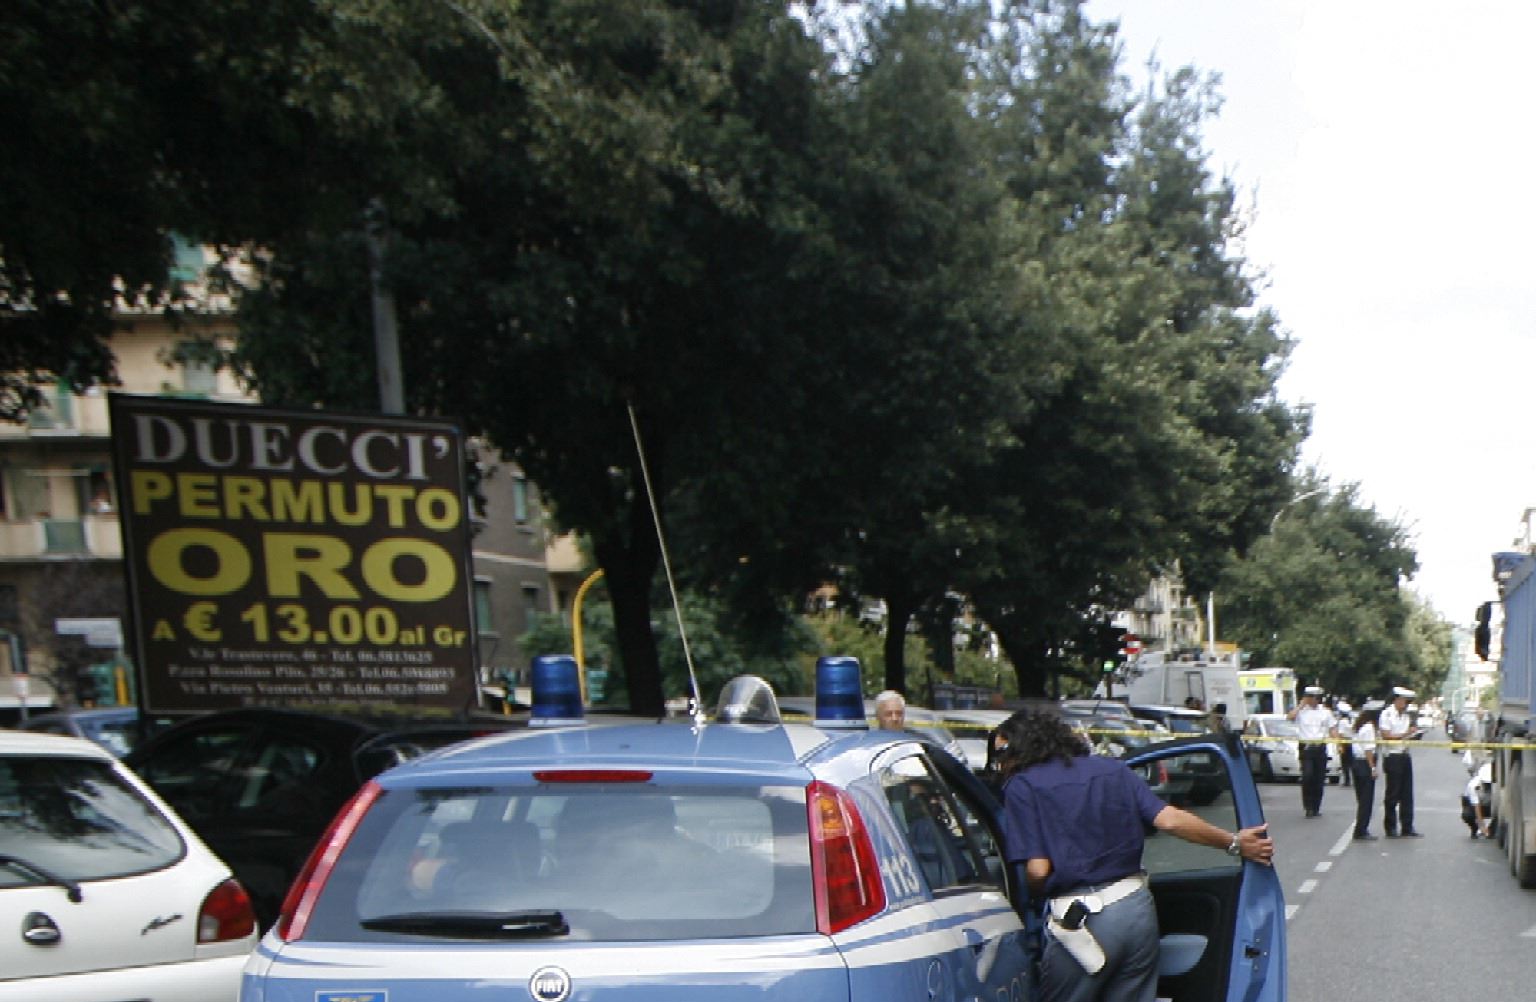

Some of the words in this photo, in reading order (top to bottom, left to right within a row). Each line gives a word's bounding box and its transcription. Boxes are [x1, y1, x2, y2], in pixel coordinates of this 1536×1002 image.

[133, 415, 449, 480] DUECCI'
[131, 470, 461, 532] PERMUTO
[147, 528, 457, 602] ORO
[152, 619, 176, 642] A
[184, 601, 222, 642] €
[241, 603, 398, 645] 13.00
[881, 854, 920, 897] 113
[536, 979, 563, 993] FIAT
